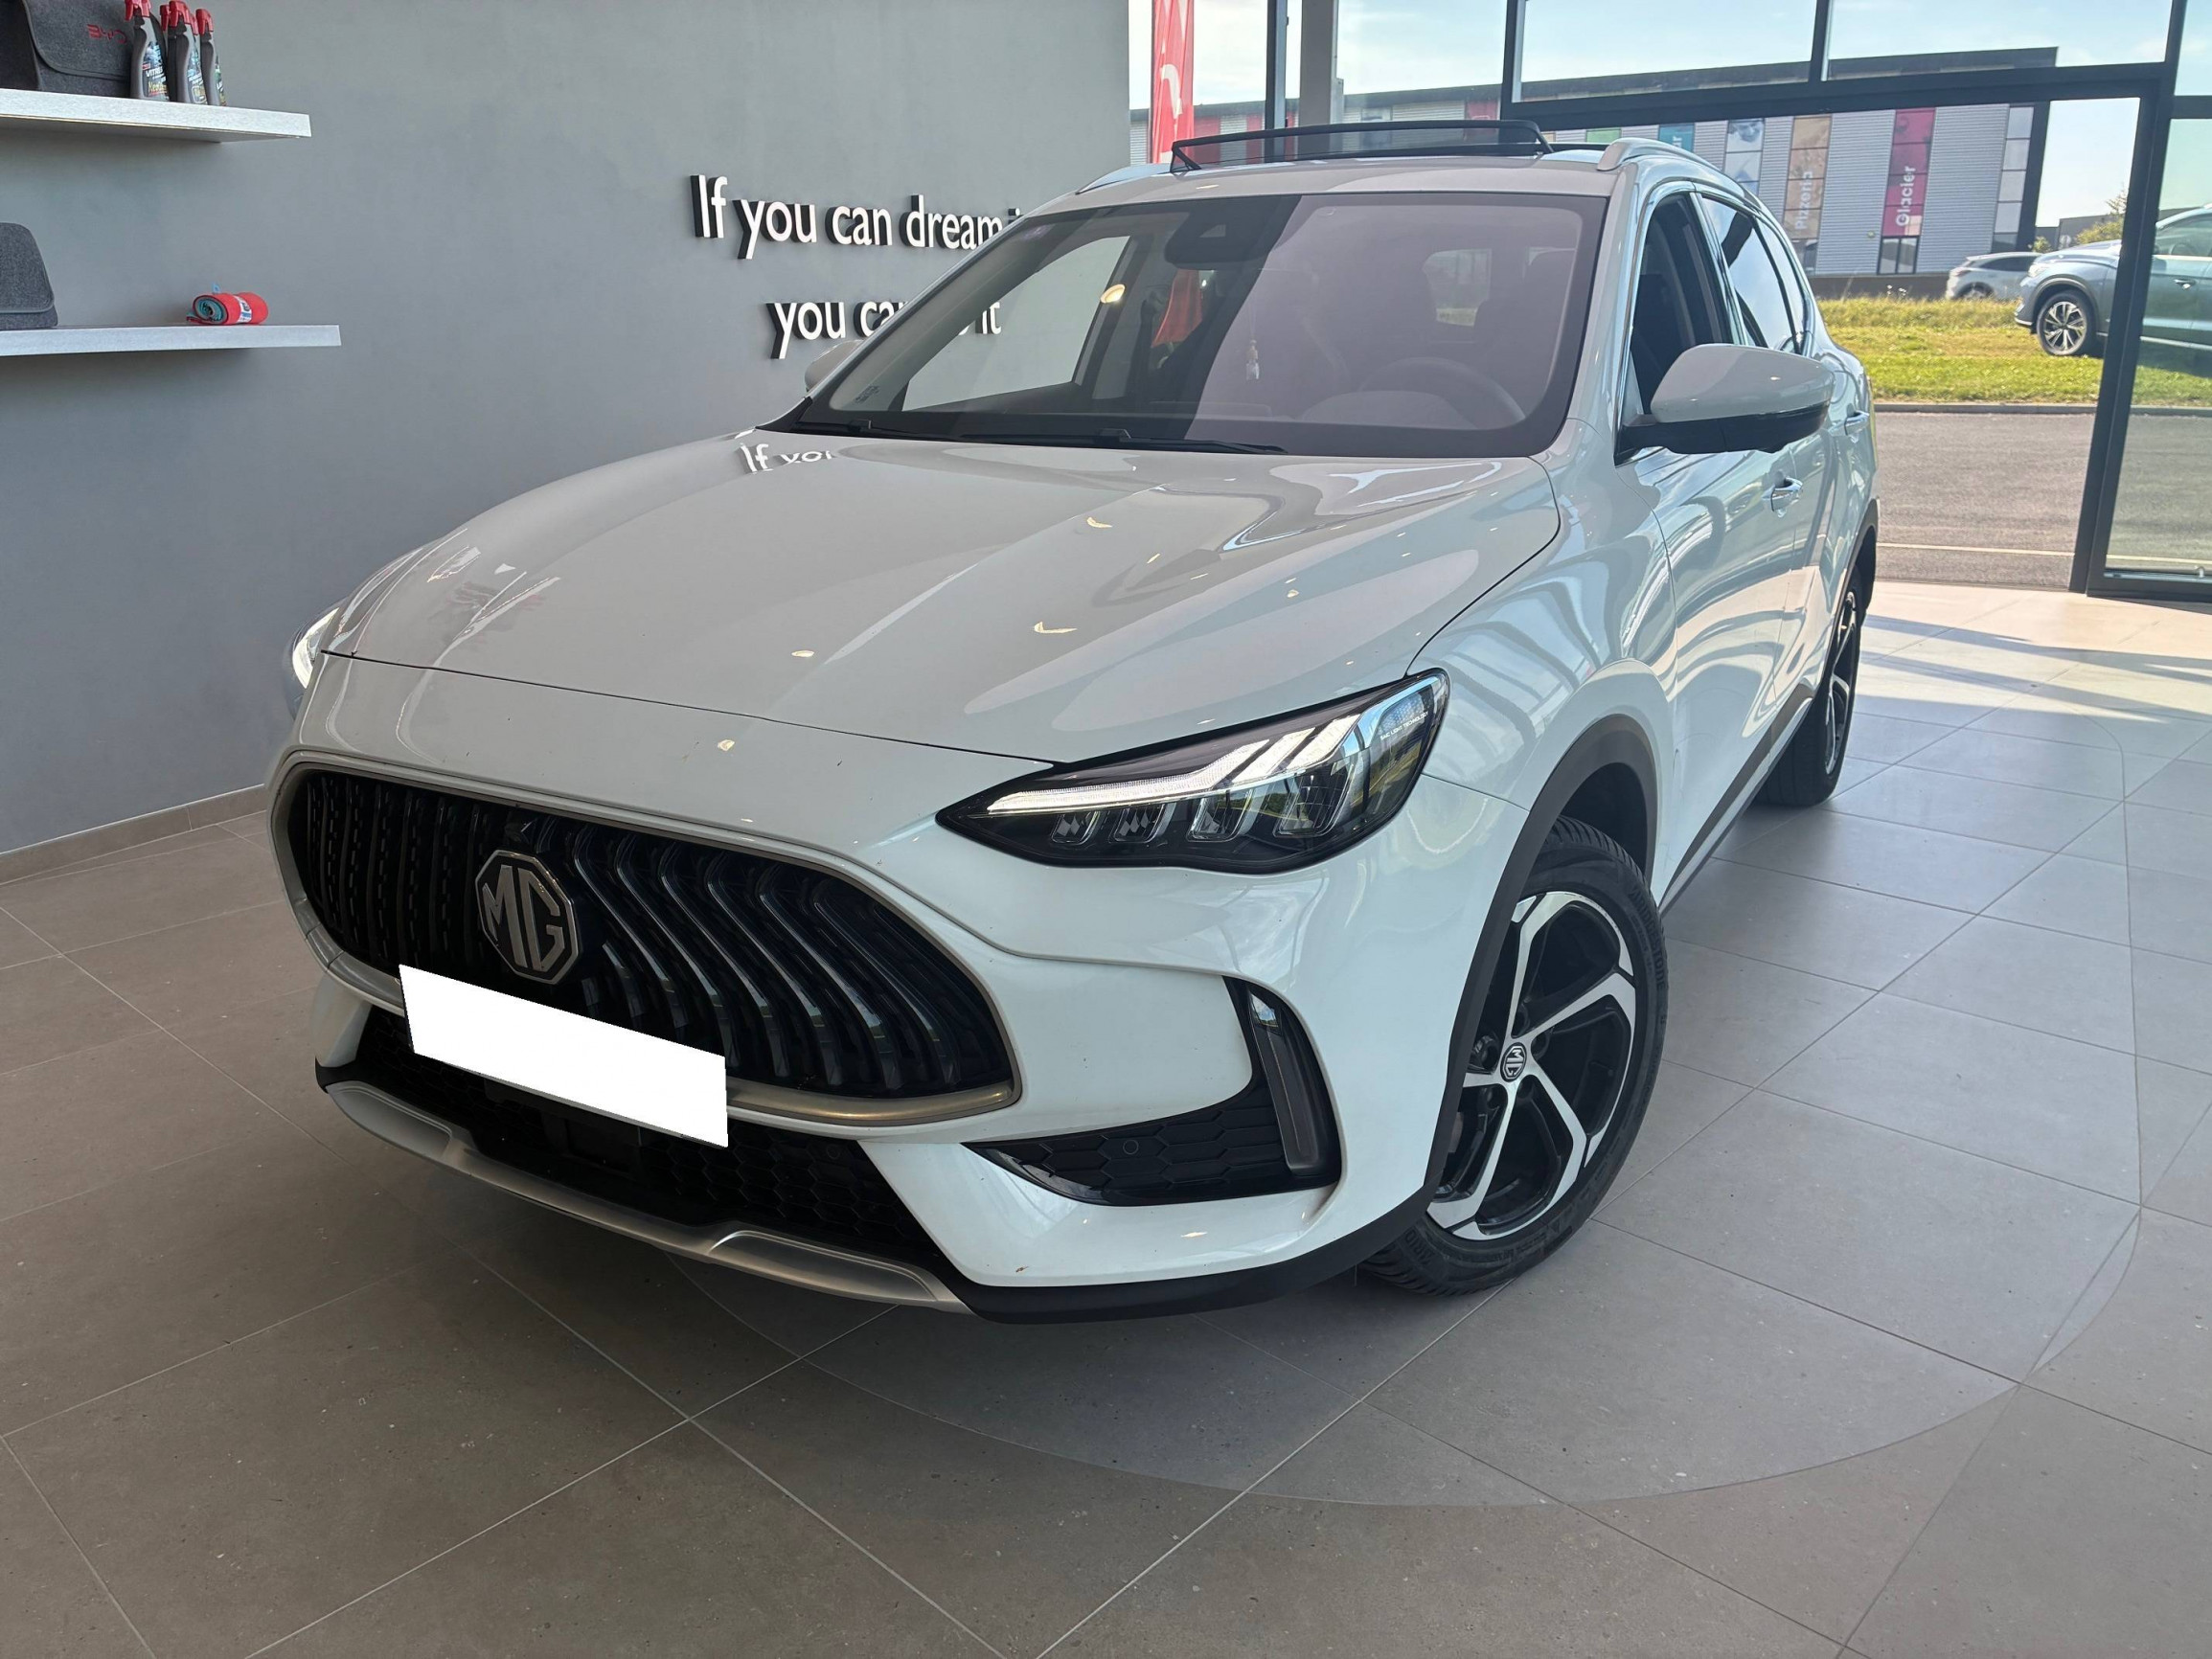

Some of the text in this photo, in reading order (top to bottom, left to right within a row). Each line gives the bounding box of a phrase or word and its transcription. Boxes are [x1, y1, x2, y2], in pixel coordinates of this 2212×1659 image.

[87, 23, 126, 44] BYD
[690, 174, 1003, 260] If you can dream
[1896, 166, 1916, 226] Glacier
[765, 302, 846, 359] you
[854, 301, 908, 337] ca
[481, 863, 566, 973] MG
[1505, 1048, 1525, 1078] MG
